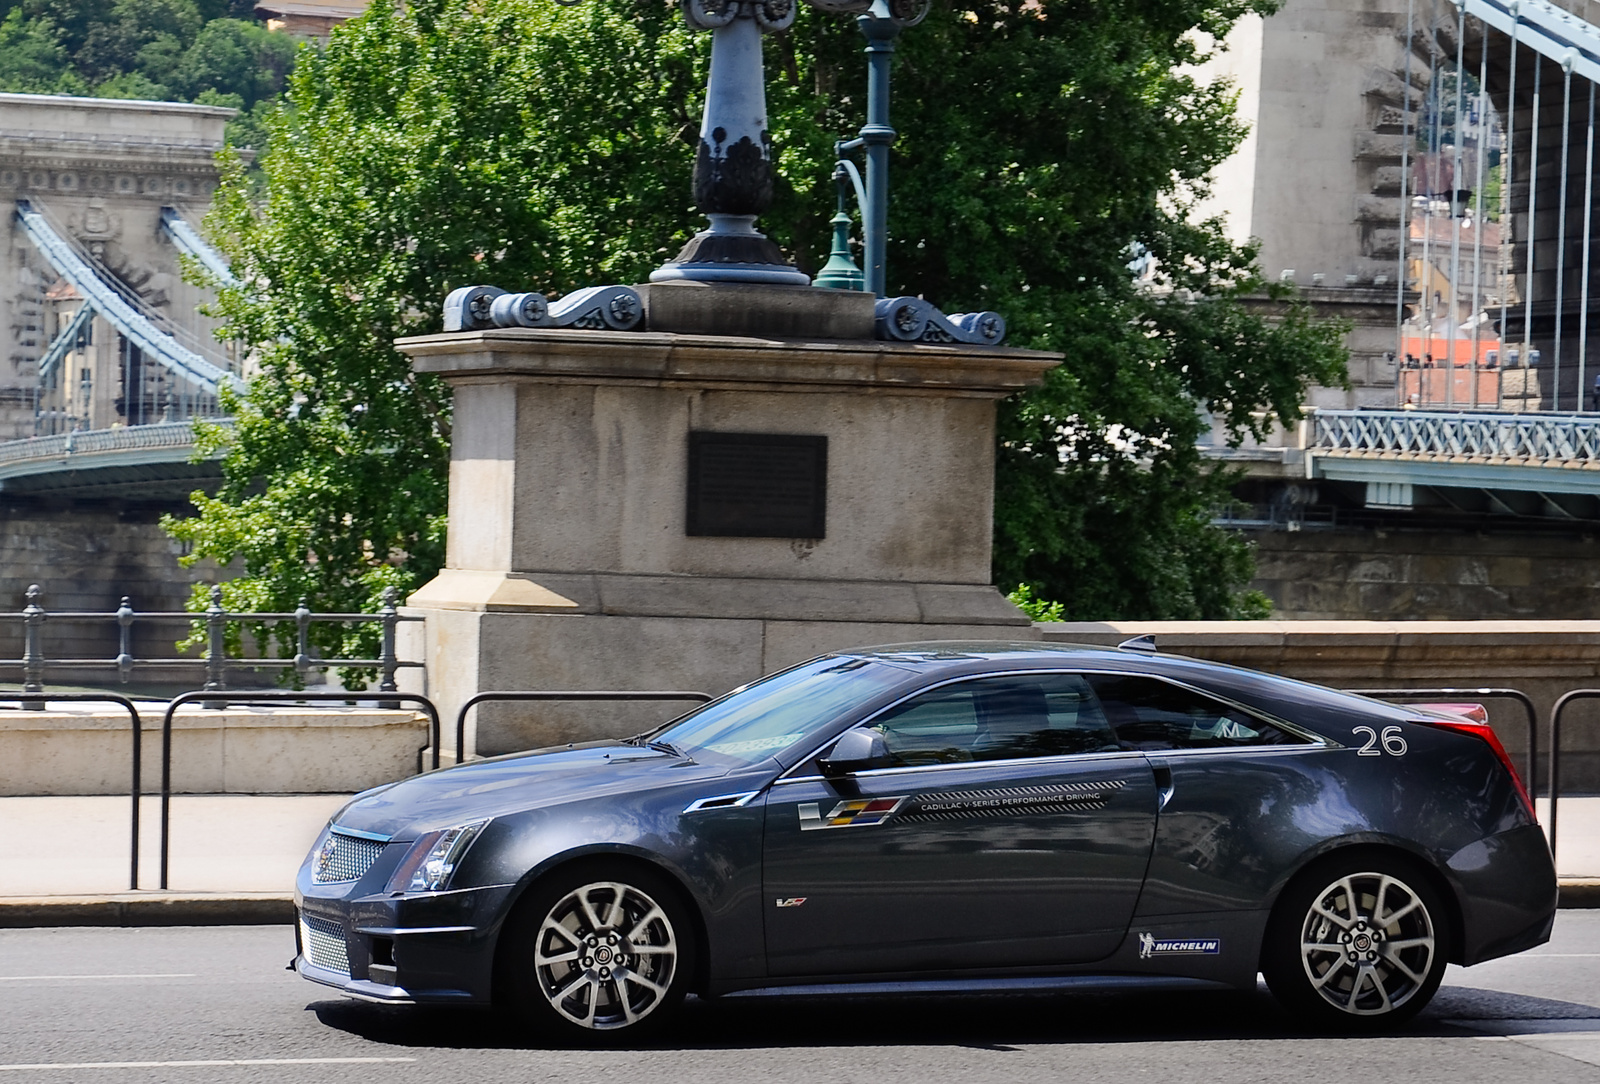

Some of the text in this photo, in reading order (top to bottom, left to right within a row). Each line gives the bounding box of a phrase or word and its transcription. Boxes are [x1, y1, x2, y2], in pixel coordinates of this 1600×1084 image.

[1352, 725, 1408, 756] 26
[921, 792, 1101, 811] CADILLAC V-SERIES PERFORMANCE DRIVING
[1155, 942, 1217, 951] MICHELIN
